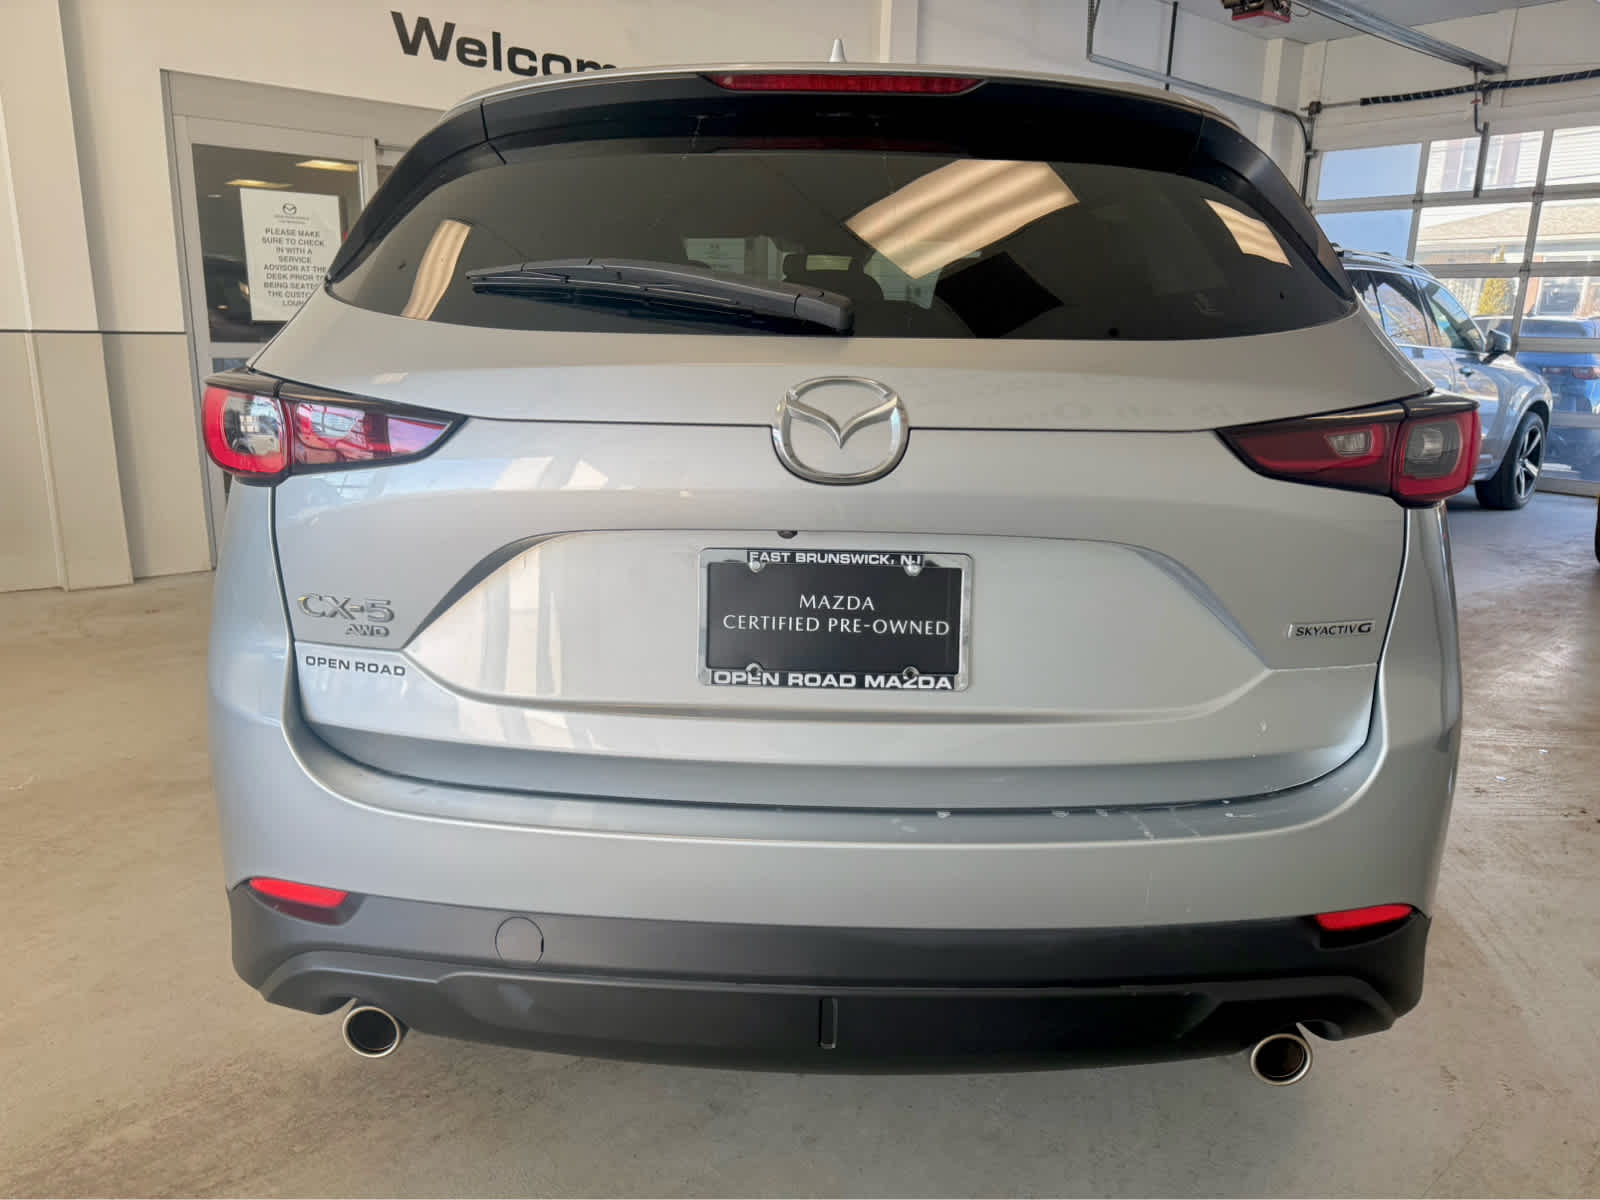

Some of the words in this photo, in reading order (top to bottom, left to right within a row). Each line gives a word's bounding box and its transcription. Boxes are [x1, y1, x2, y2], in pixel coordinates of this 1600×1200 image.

[264, 228, 296, 237] PLEASE
[298, 229, 321, 238] MAKE
[262, 236, 282, 245] SURE
[285, 238, 296, 246] TO
[298, 238, 325, 247] CHECK
[286, 247, 306, 255] WITH
[278, 255, 312, 264] SERVICE
[263, 263, 298, 272] ADVISOR
[266, 272, 288, 280] DESK
[289, 273, 314, 281] PRIOR
[263, 281, 288, 289] BEING
[267, 290, 283, 298] THE
[285, 291, 311, 299] CUSTO
[750, 551, 790, 563] EAST
[795, 552, 895, 566] BRUNSWICK,
[297, 592, 394, 623] CX-5
[799, 594, 875, 611] MAZDA
[344, 623, 390, 638] AWD
[722, 614, 820, 633] CERTIFIED
[828, 617, 950, 636] PRE-OWNED
[305, 655, 351, 671] OPEN
[354, 661, 406, 677] ROAD
[714, 670, 780, 686] OPEN
[787, 672, 857, 688] ROAD
[864, 674, 952, 690] MAZDA
